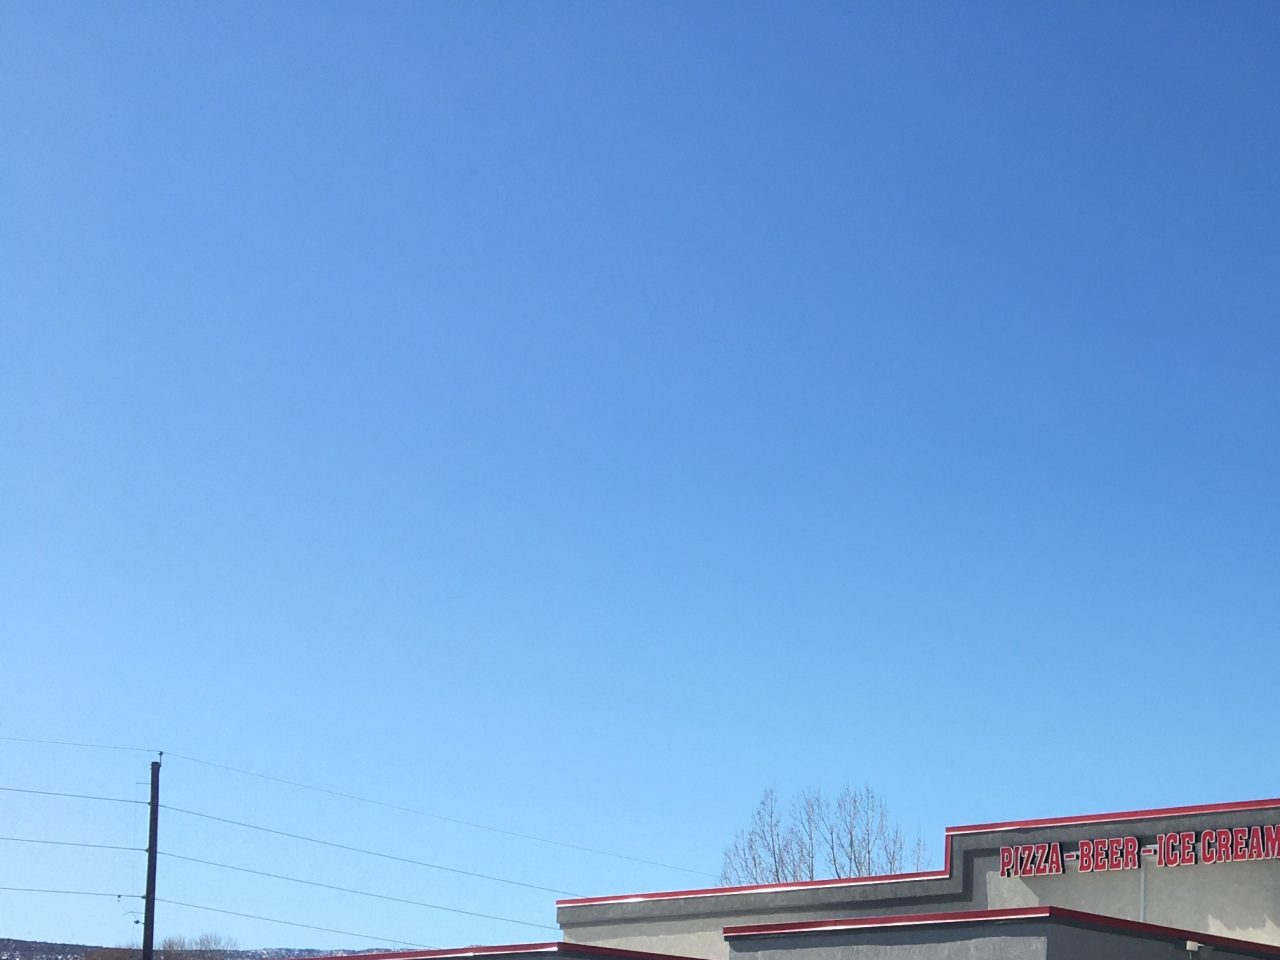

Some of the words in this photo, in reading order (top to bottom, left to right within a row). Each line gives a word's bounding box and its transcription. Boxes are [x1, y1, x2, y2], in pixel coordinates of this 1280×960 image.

[1000, 843, 1063, 878] PIZZA
[1078, 836, 1139, 872] BEER
[1156, 832, 1196, 867] ICE
